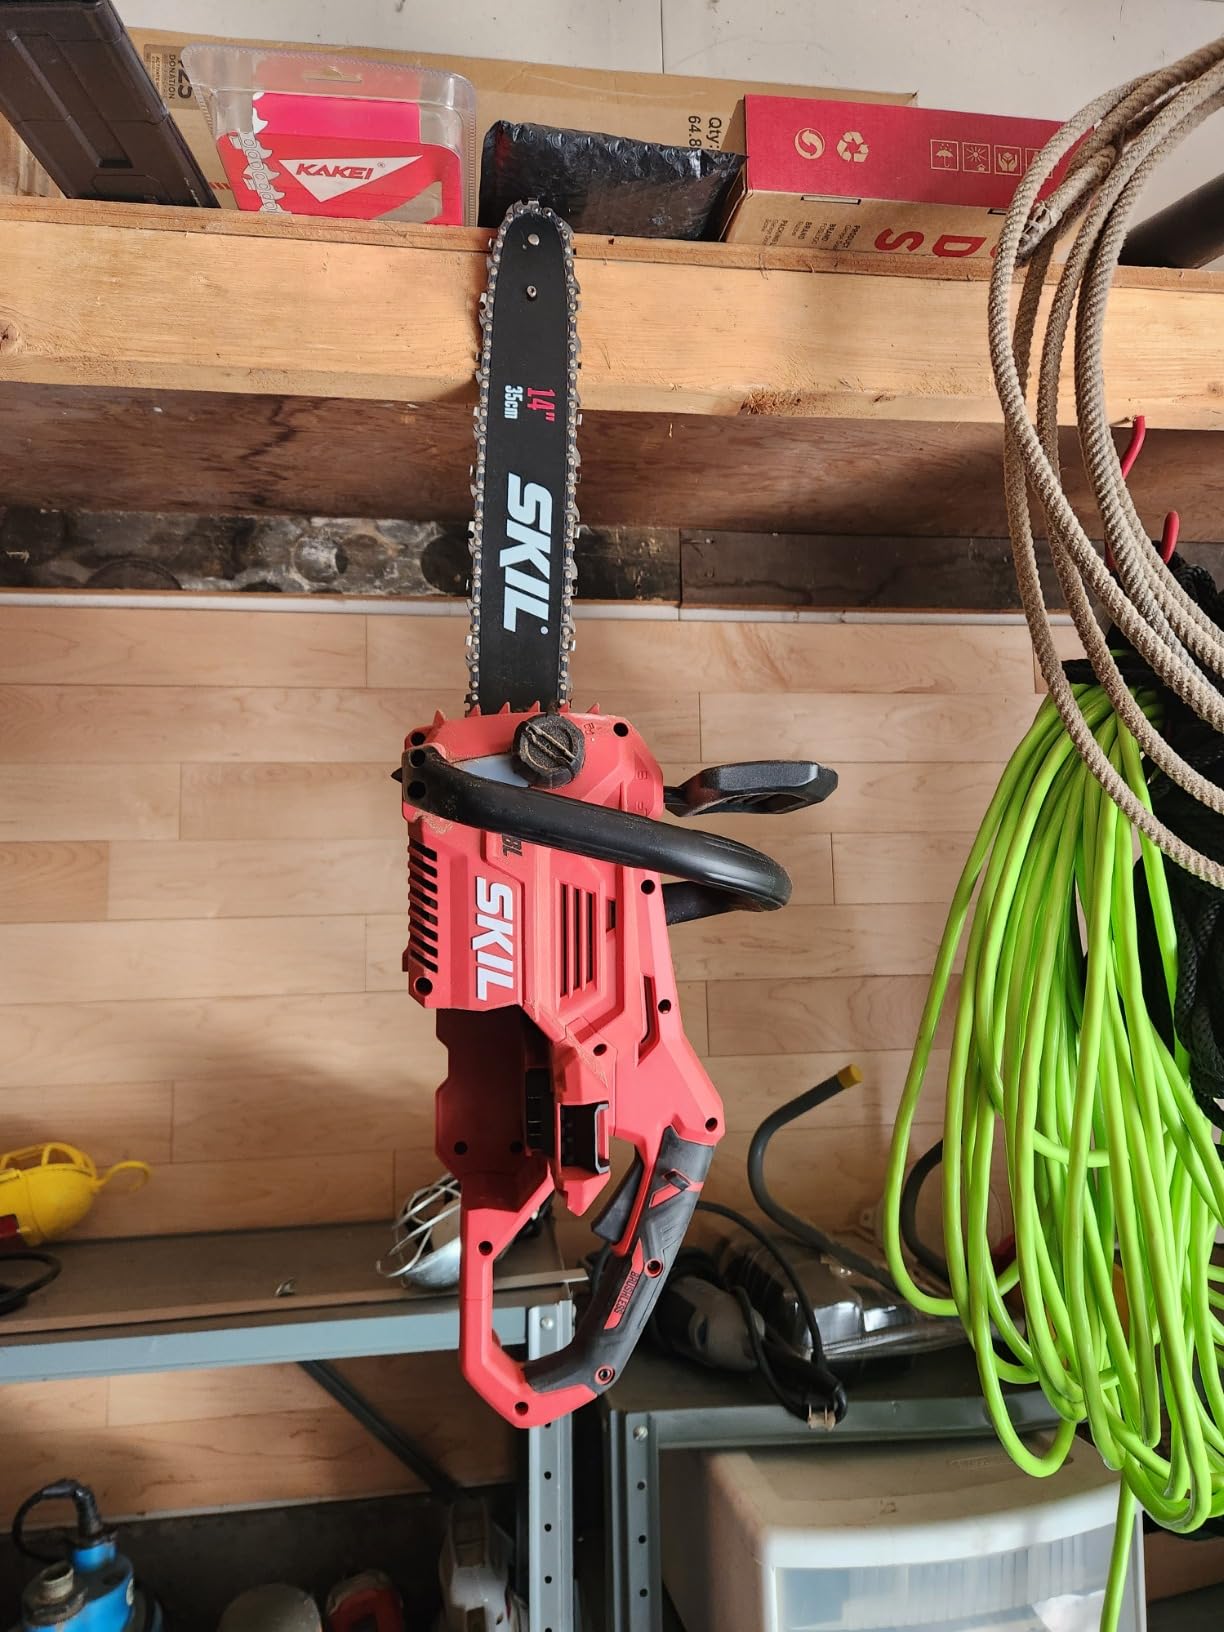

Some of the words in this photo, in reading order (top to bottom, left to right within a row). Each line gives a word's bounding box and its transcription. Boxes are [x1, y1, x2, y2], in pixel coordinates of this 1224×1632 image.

[168, 54, 176, 99] DONATION
[688, 116, 702, 147] 64.8
[706, 117, 722, 149] Qty:
[296, 163, 374, 180] KAKEI
[798, 221, 813, 240] BRAND
[822, 223, 837, 241] BRAND
[504, 385, 524, 420] 35cm
[527, 387, 556, 422] 14"
[499, 472, 552, 633] SKIL
[471, 876, 514, 1002] SKIL
[614, 1271, 639, 1314] BRUSHLESS
